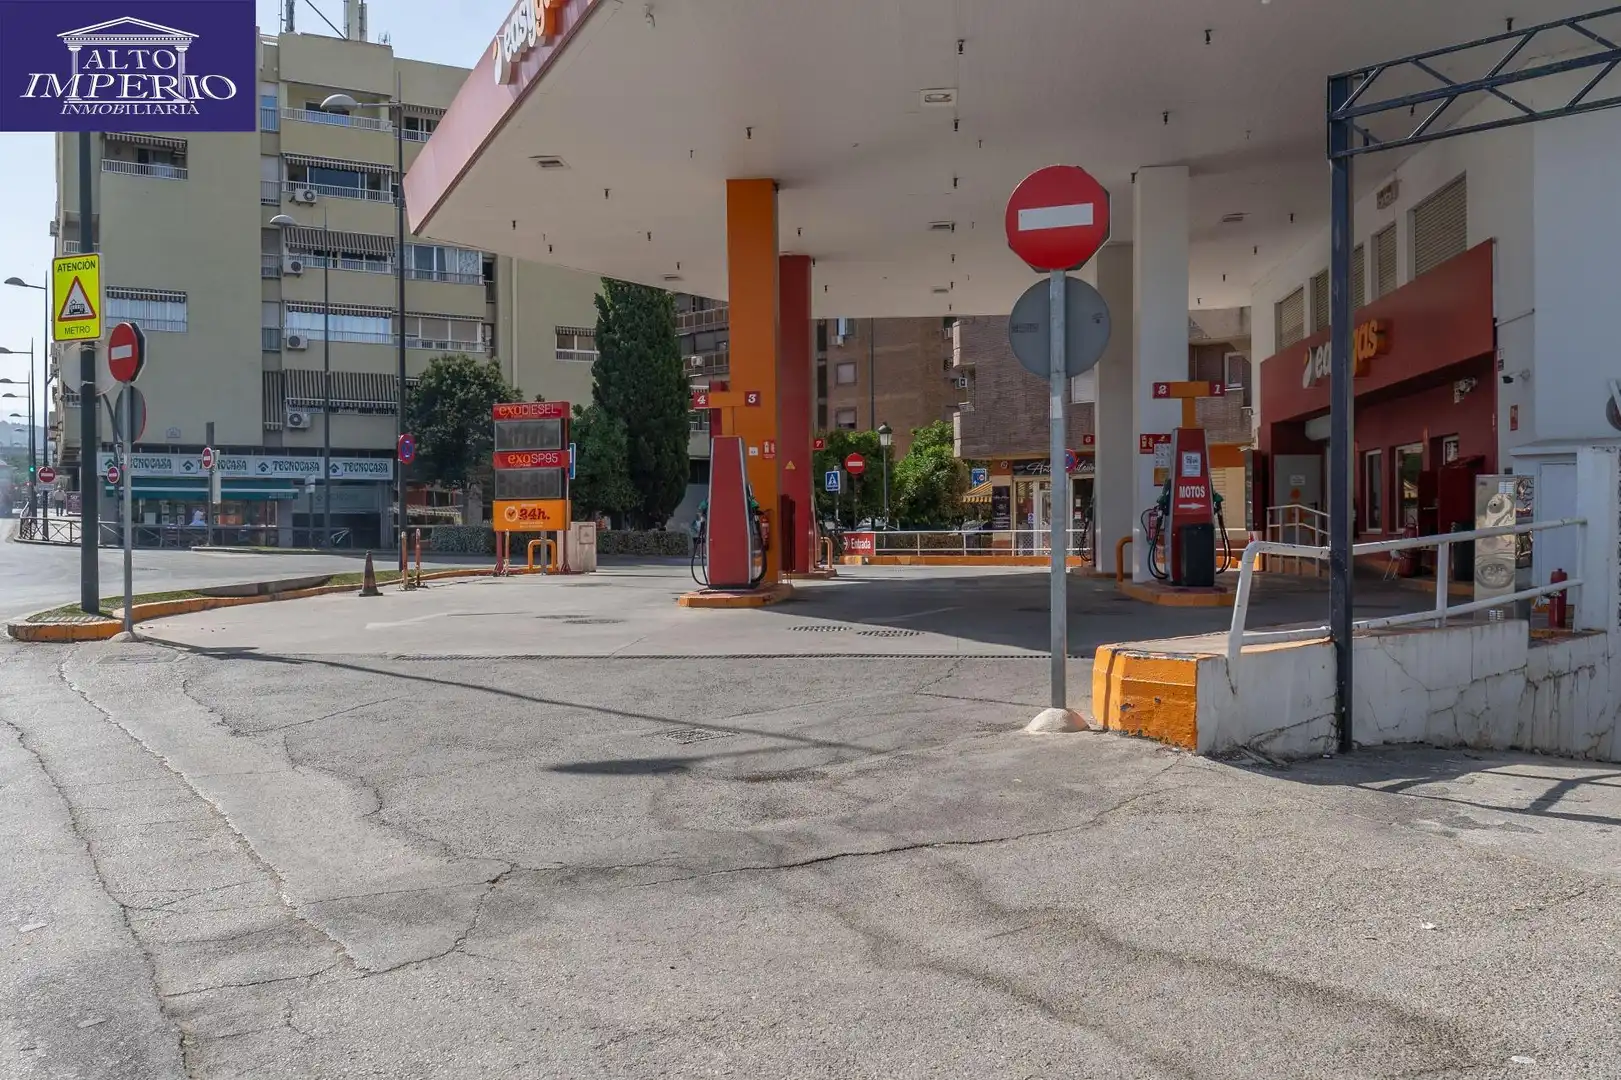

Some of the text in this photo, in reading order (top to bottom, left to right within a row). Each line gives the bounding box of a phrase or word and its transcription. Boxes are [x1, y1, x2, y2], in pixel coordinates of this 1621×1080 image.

[504, 0, 550, 62] easyg
[57, 259, 96, 272] ATENCIÓN
[64, 325, 91, 335] METRO
[1158, 384, 1167, 395] 2
[1214, 384, 1221, 394] 1
[697, 395, 706, 404] 4
[747, 394, 757, 403] 3
[272, 460, 320, 471] TECNOCASA
[342, 462, 388, 473] TECNOCASA
[1179, 485, 1206, 498] MOTOS
[851, 537, 871, 549] Entrada
